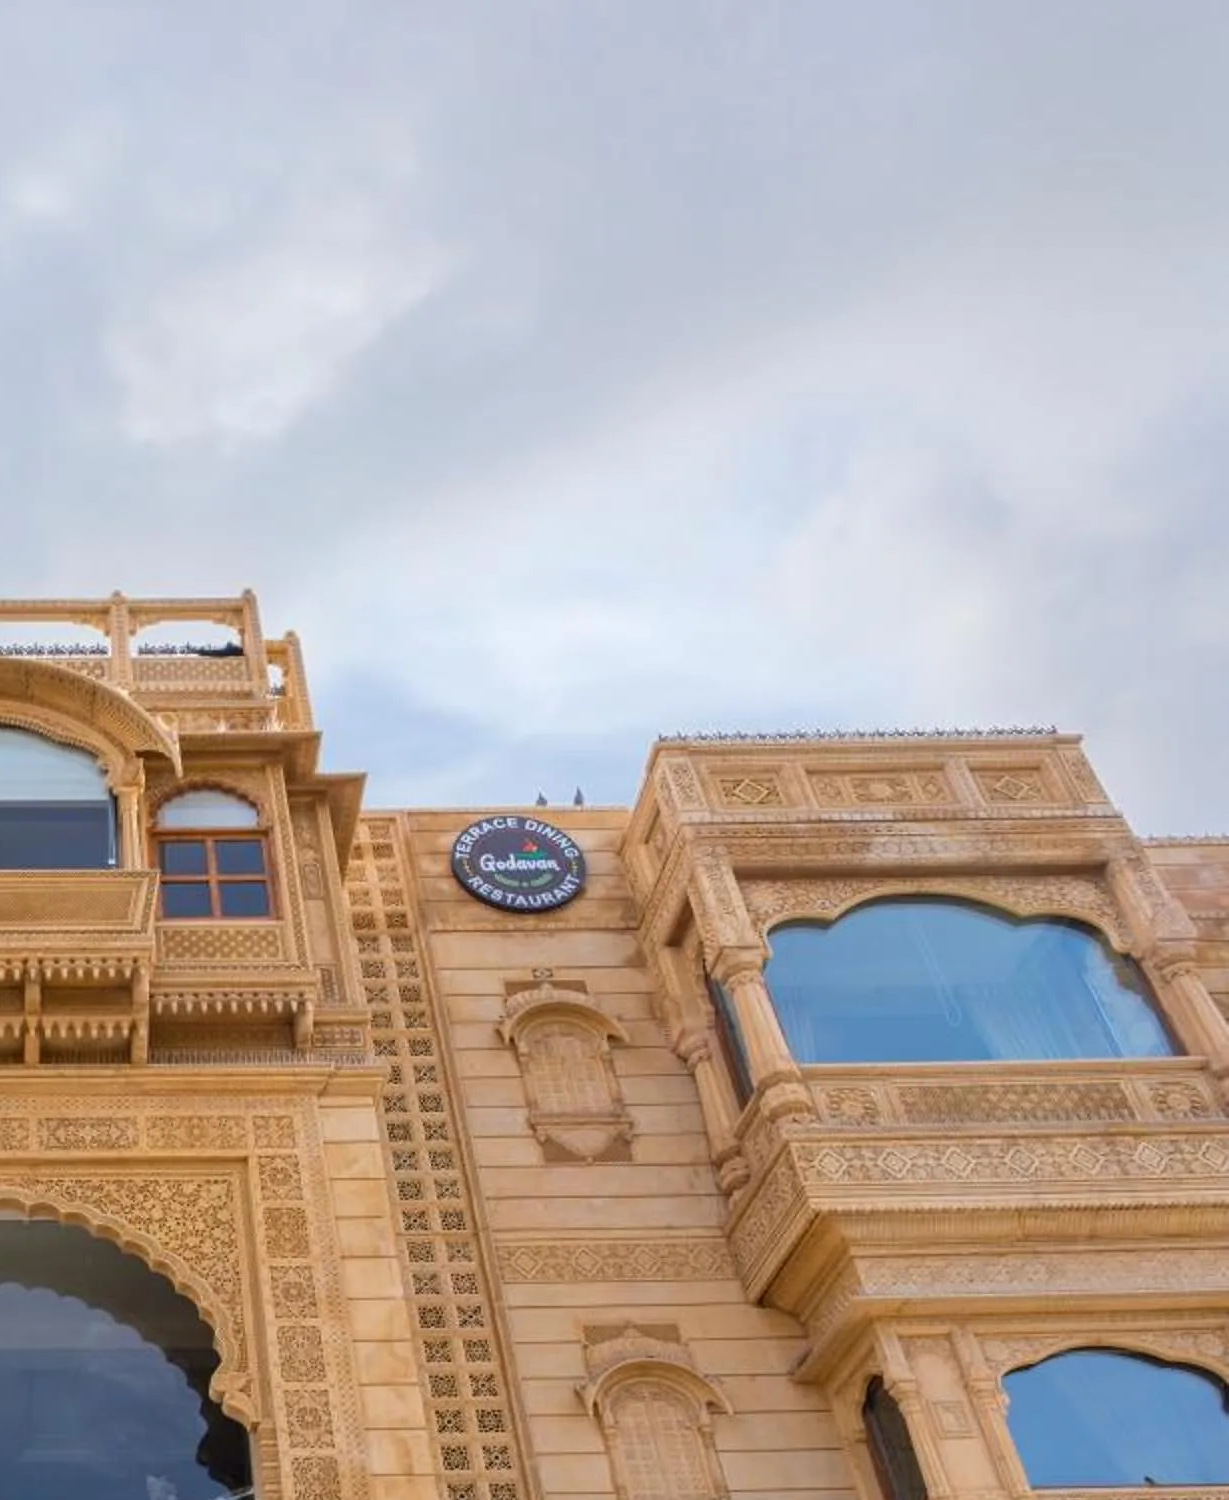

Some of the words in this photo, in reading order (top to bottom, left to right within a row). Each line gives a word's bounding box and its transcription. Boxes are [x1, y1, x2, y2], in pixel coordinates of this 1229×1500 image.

[455, 817, 518, 858] TERRACE
[524, 819, 579, 858] DINING
[479, 853, 561, 872] Godavan
[468, 874, 580, 907] RESTAURANT
